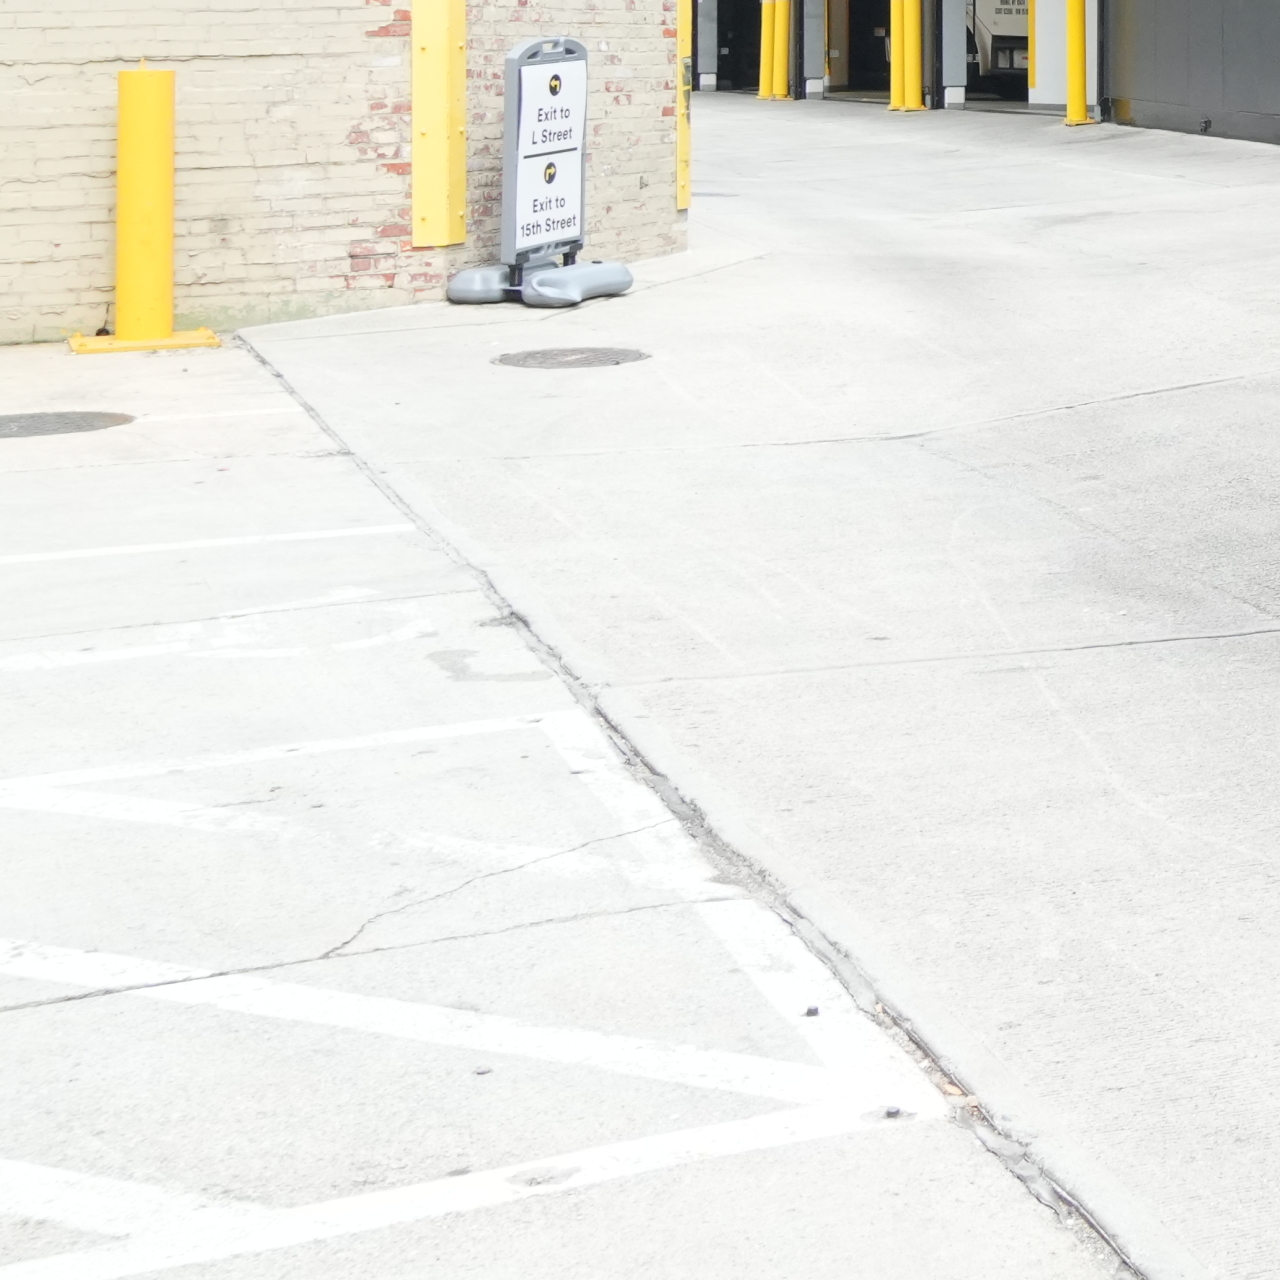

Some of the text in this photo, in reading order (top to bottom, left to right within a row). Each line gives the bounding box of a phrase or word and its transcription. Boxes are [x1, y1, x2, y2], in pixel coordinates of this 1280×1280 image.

[537, 105, 571, 122] Exit to
[532, 126, 573, 145] L Street
[532, 196, 566, 213] Exit to
[520, 214, 576, 238] 15th Street
